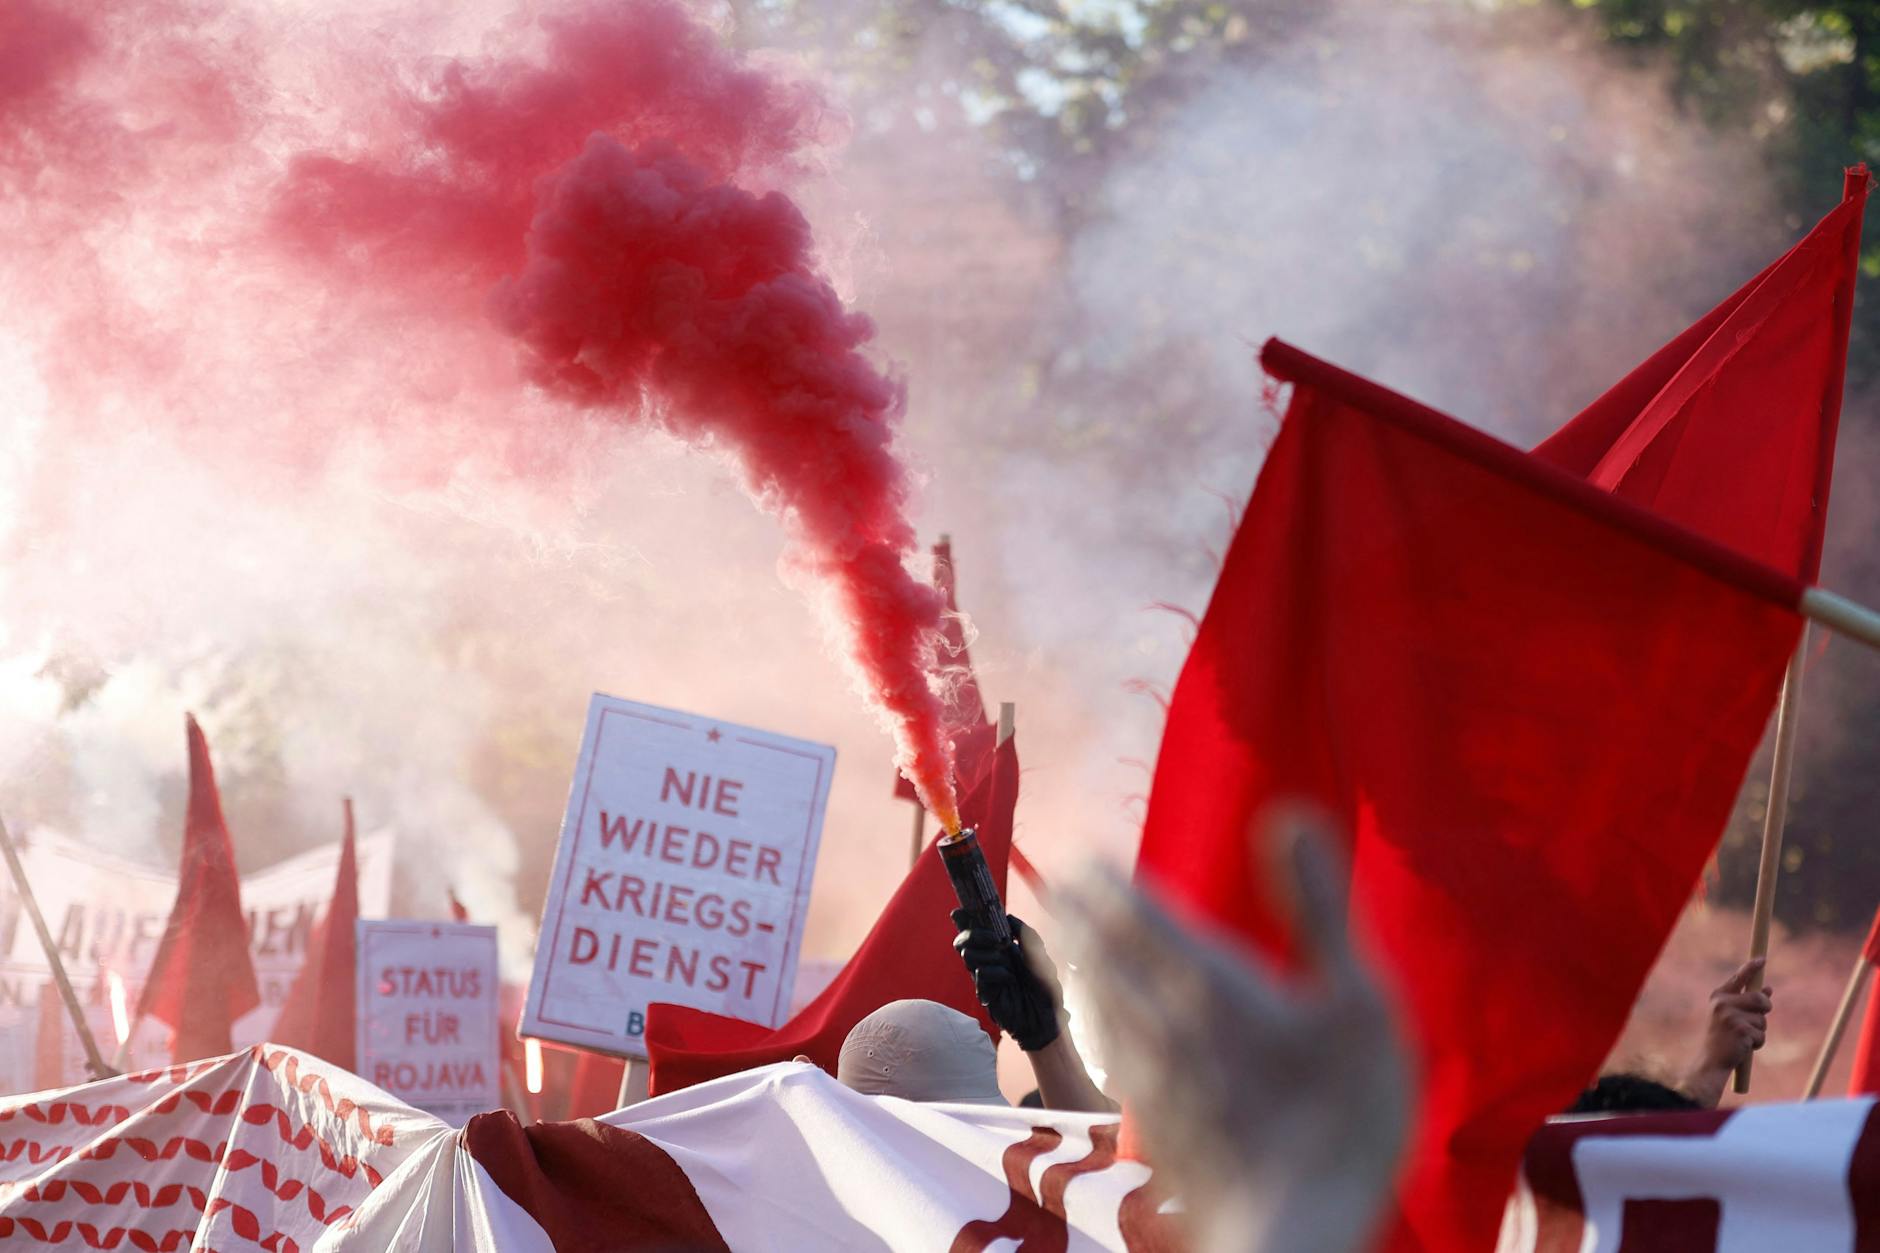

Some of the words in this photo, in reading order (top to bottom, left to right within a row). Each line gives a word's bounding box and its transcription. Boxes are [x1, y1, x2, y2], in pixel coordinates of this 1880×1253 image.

[660, 767, 743, 817] NIE
[599, 810, 783, 886] WIEDER
[580, 868, 775, 937] KRIEGS-
[380, 966, 481, 999] STATUS
[568, 927, 766, 999] DIENST
[405, 1008, 460, 1045] FÜR
[375, 1061, 487, 1090] ROJAVA
